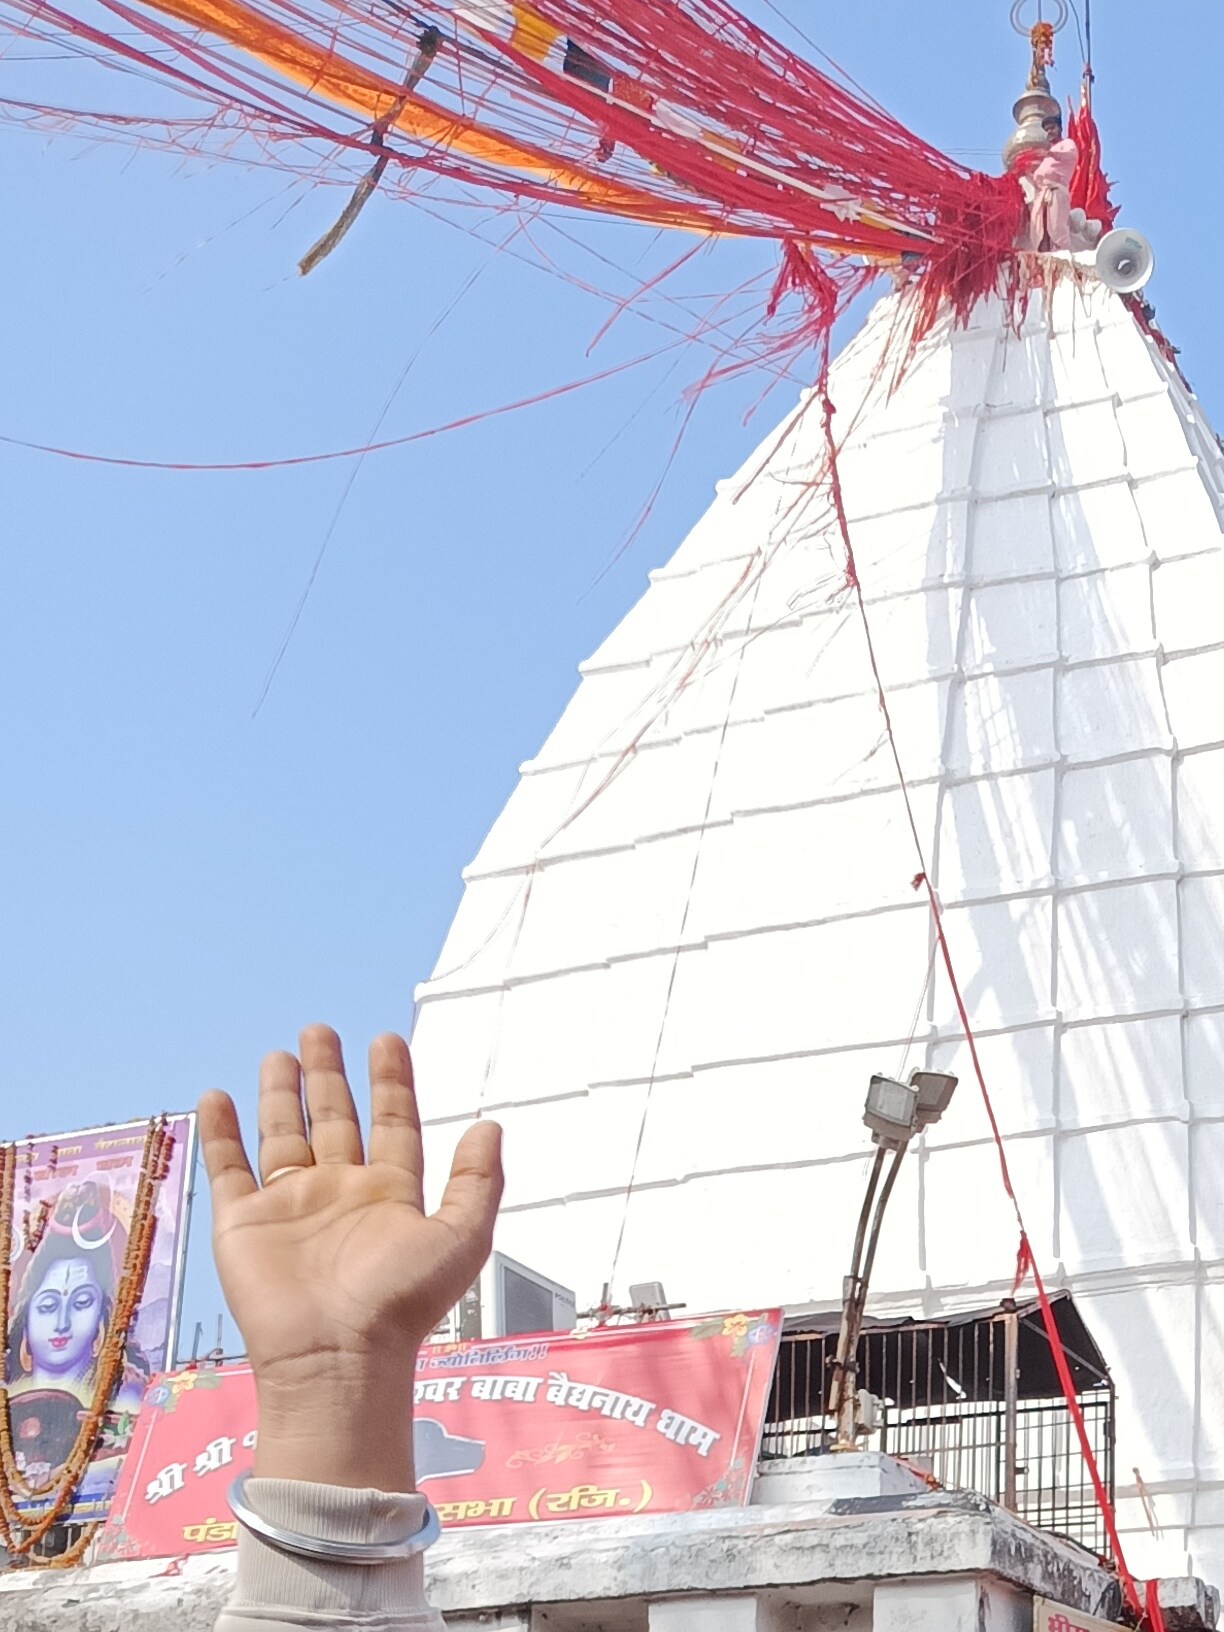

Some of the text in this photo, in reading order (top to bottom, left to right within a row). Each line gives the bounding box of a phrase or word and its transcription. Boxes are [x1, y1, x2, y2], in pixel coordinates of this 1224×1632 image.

[144, 1462, 188, 1504] श्री
[192, 1436, 236, 1476] श्री
[471, 1375, 544, 1403] बाबा
[656, 1408, 720, 1457] धाम
